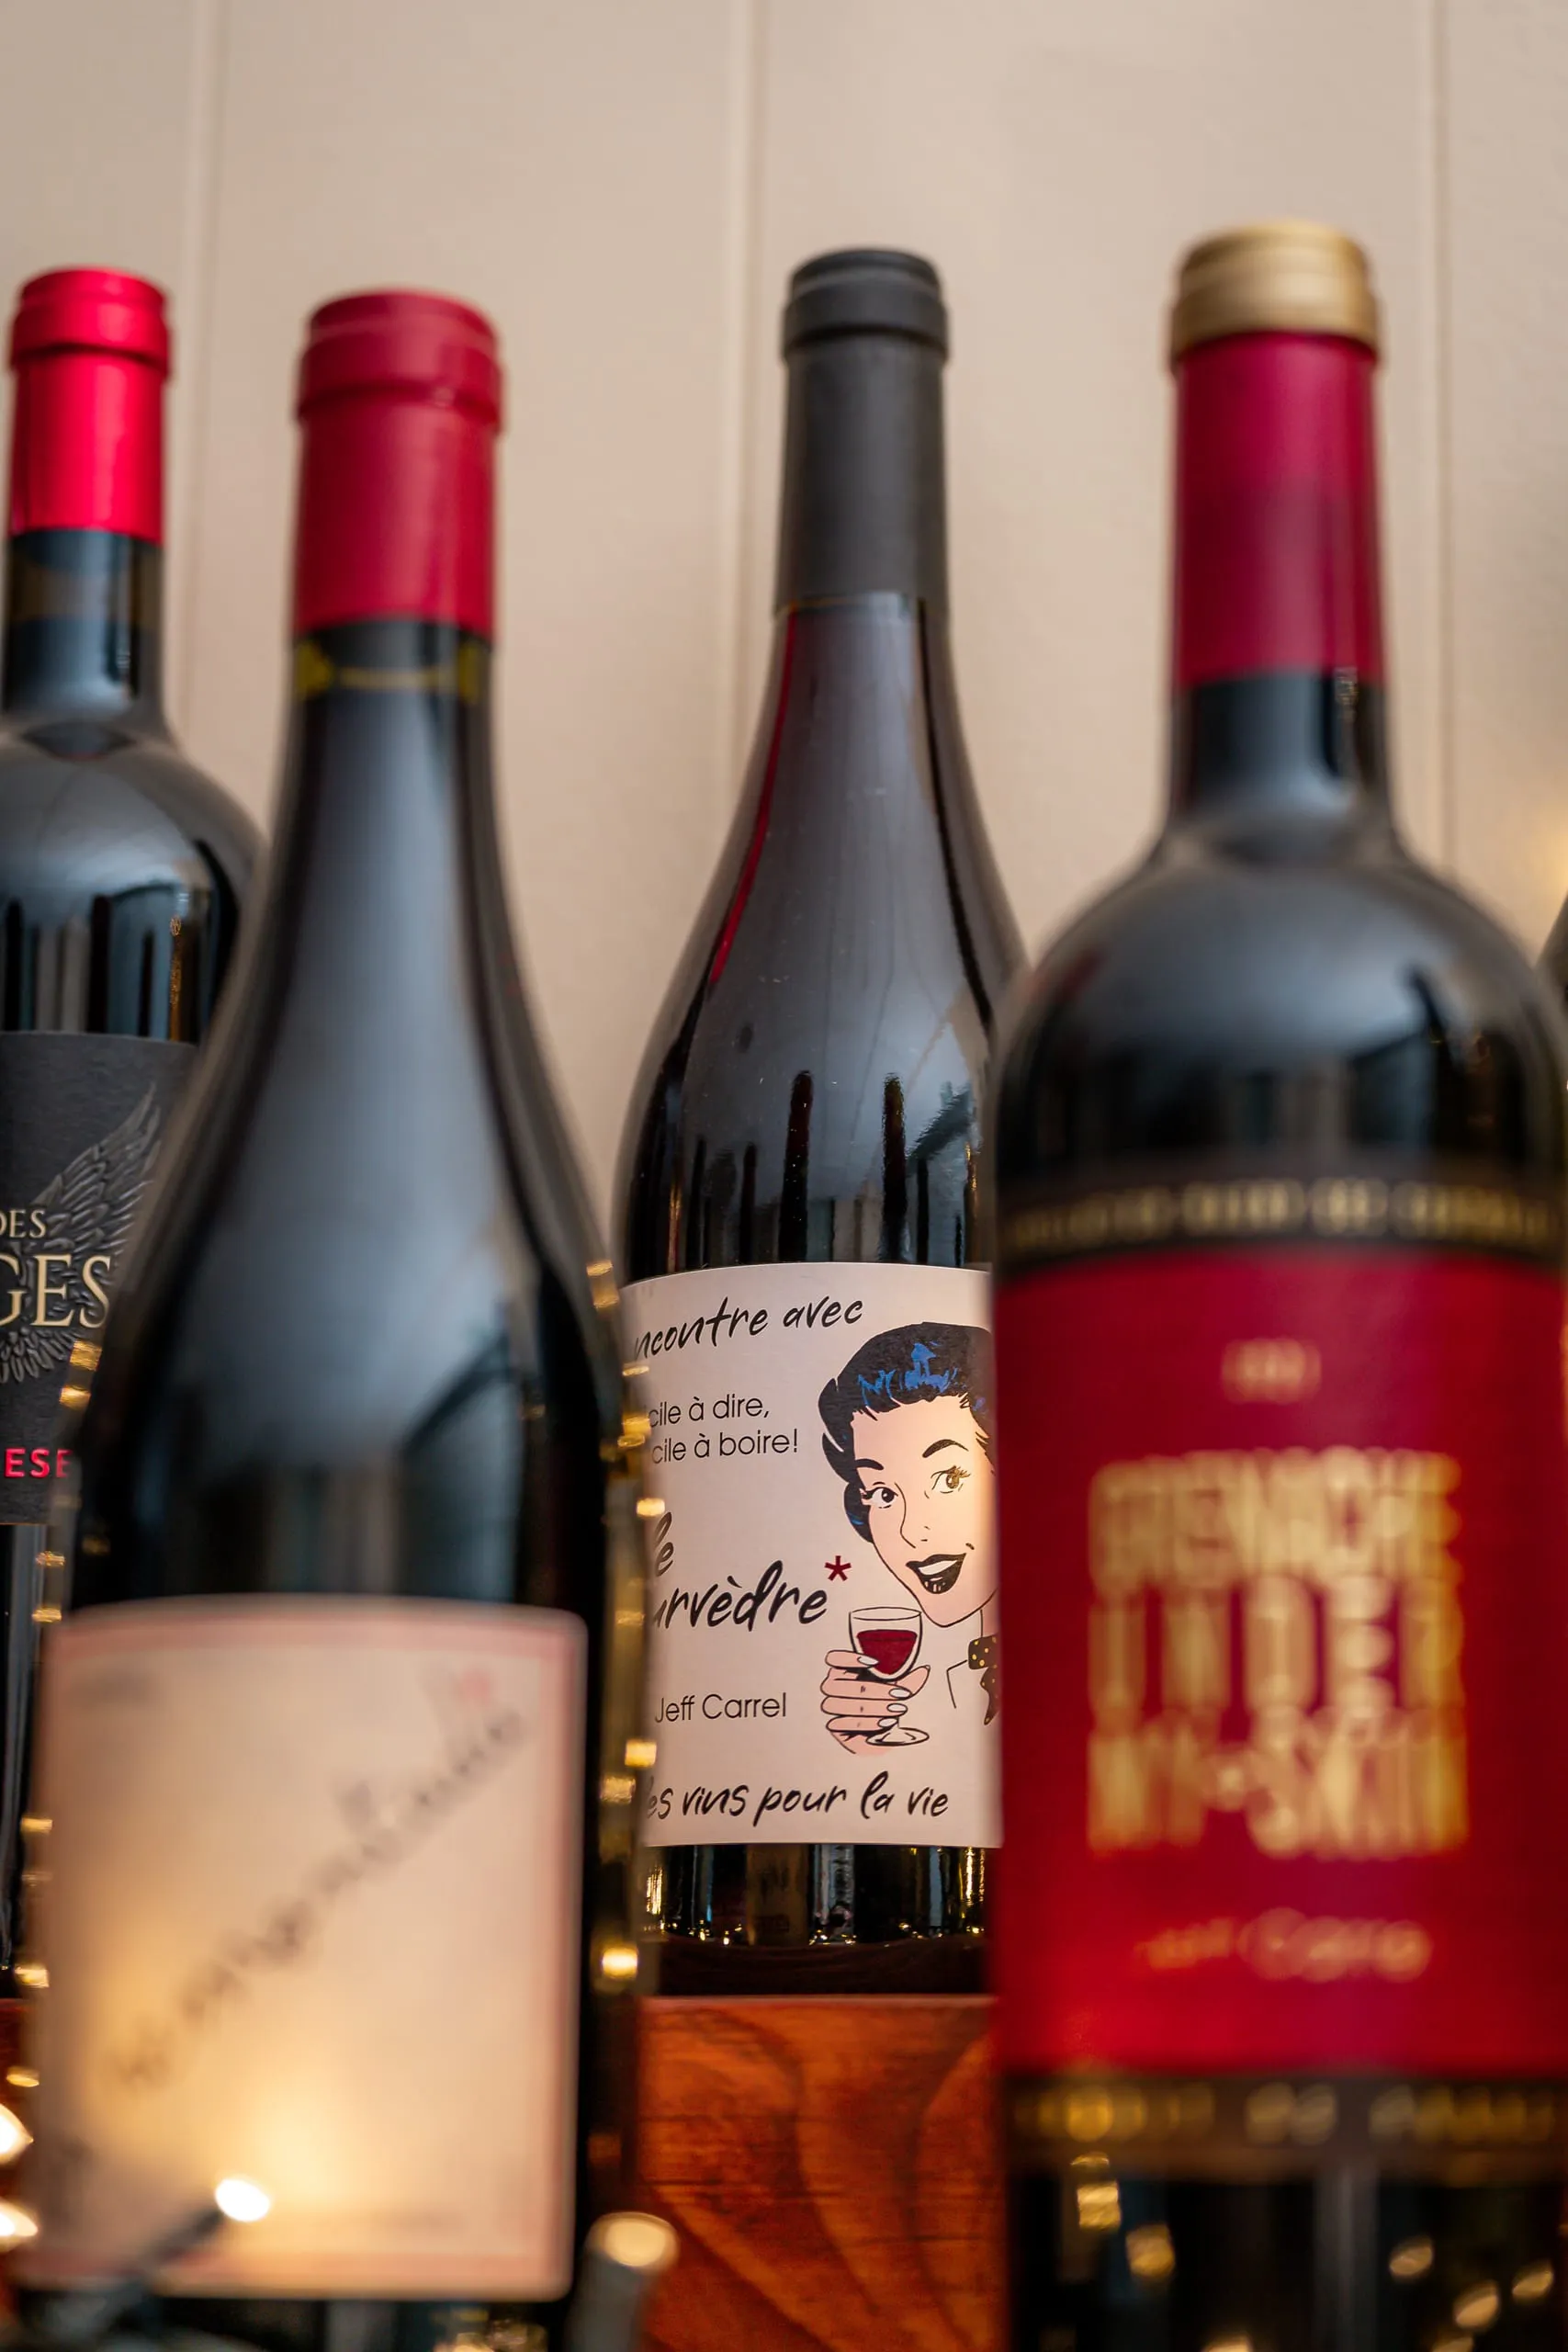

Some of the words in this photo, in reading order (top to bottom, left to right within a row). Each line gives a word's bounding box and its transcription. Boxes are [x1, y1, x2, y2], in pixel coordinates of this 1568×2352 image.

[784, 1295, 863, 1329] avec
[649, 1402, 681, 1428] cile
[689, 1396, 704, 1421] à
[713, 1394, 770, 1419] dire,
[651, 1438, 686, 1464] cile
[694, 1433, 710, 1458] à
[720, 1429, 797, 1456] boire!
[655, 1695, 695, 1723] Jeff
[703, 1692, 786, 1719] Carrel
[647, 1775, 673, 1819] es
[682, 1785, 749, 1816] vins
[753, 1785, 846, 1826] pour
[861, 1771, 894, 1819] la
[908, 1787, 948, 1816] vie
